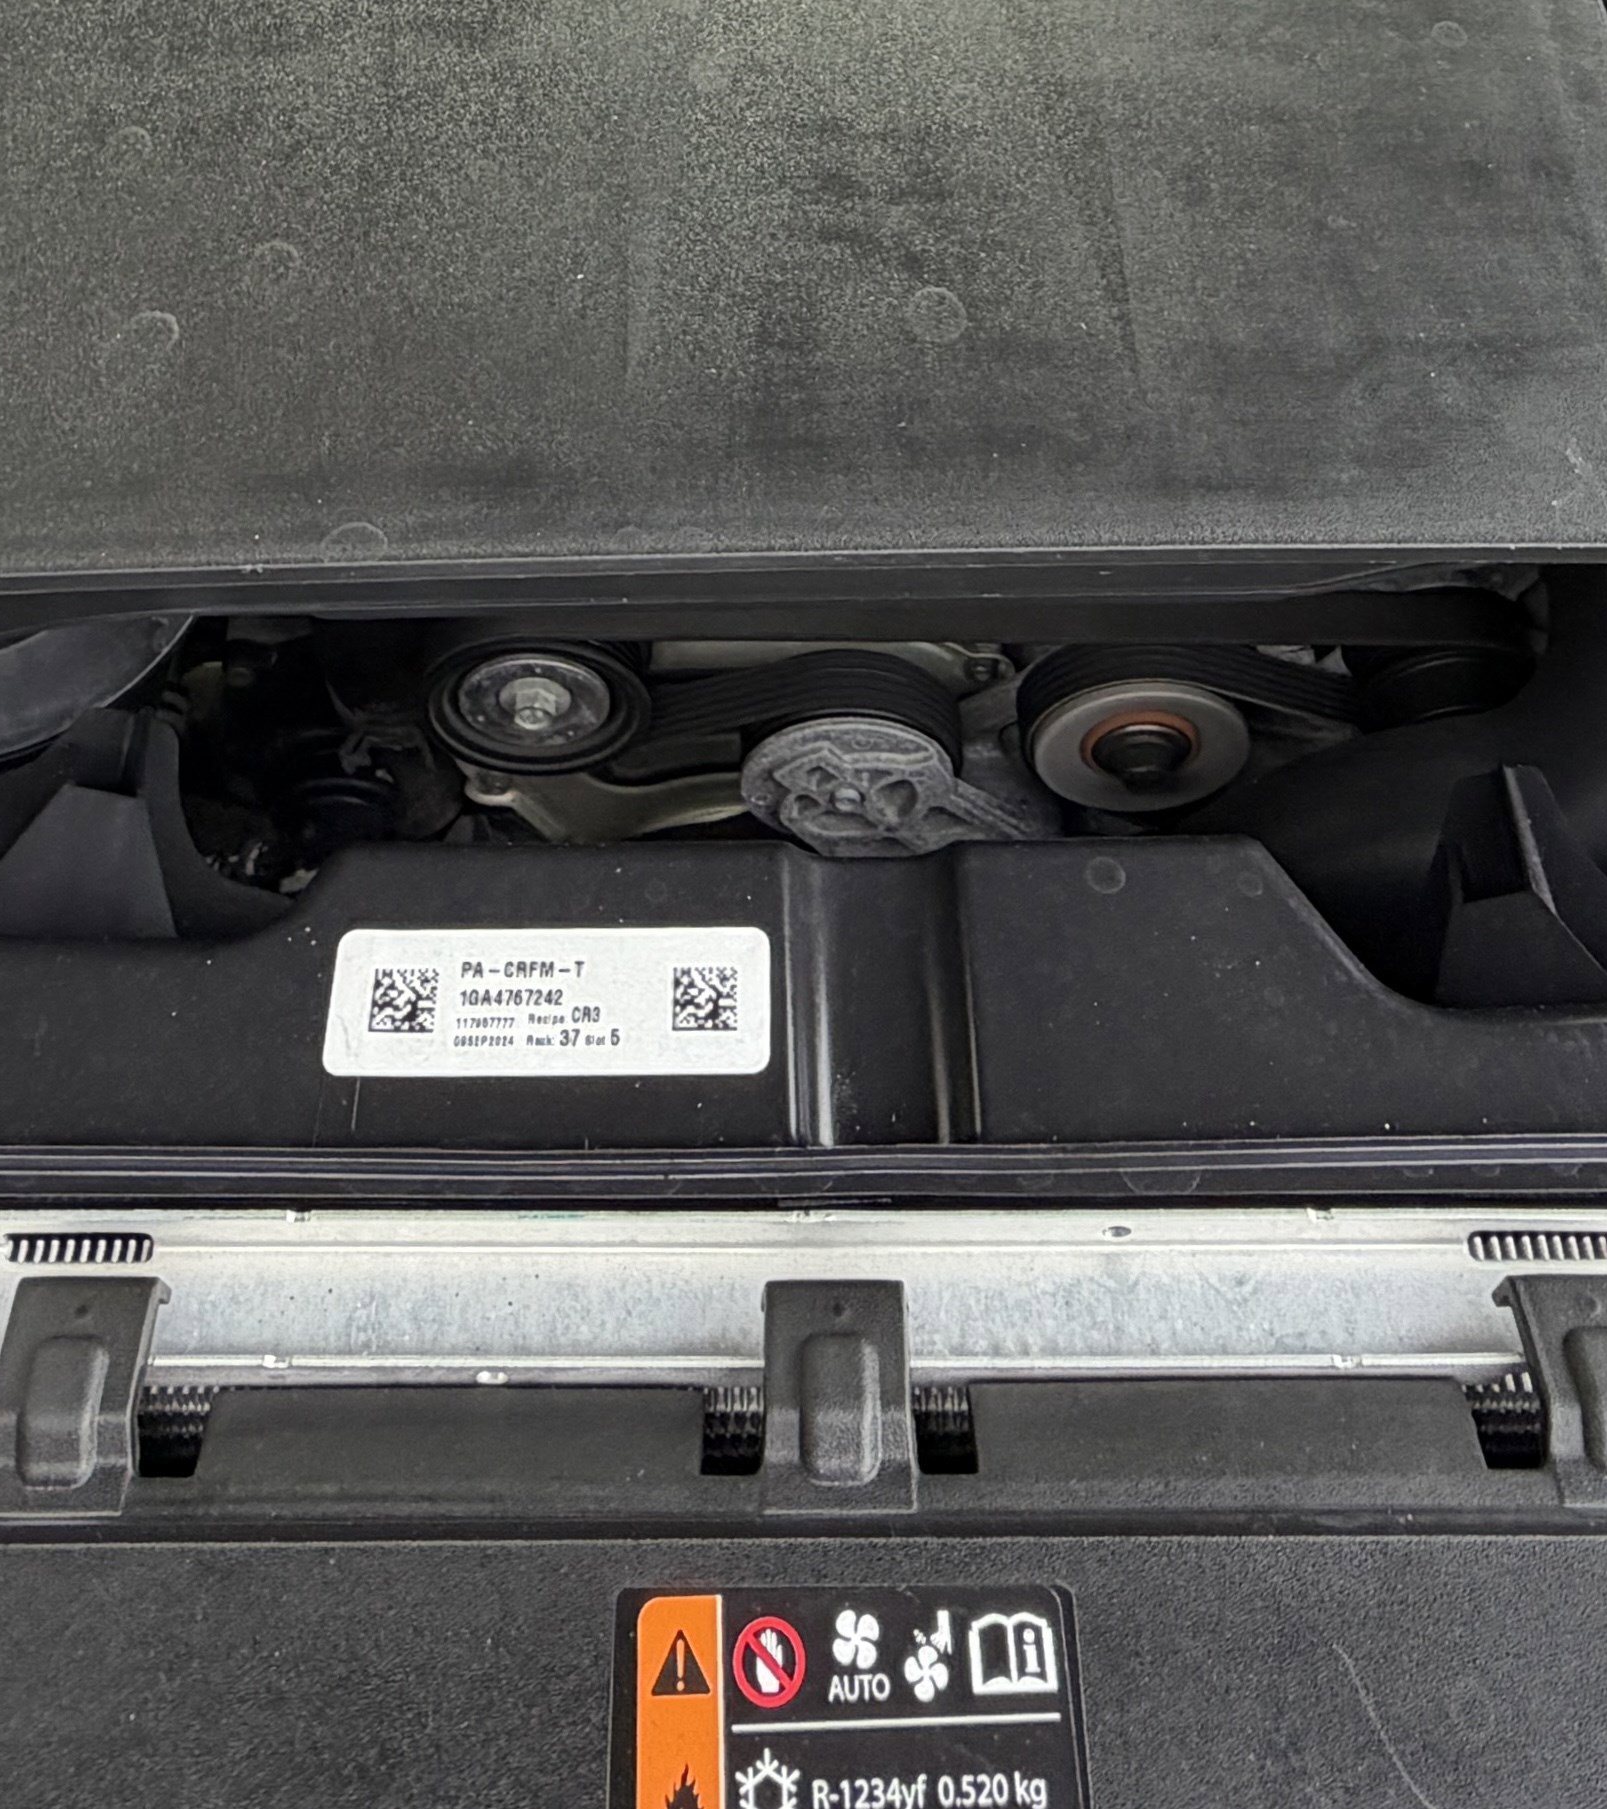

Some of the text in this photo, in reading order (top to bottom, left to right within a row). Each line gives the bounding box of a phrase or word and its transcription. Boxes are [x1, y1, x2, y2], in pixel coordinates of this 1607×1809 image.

[571, 1006, 602, 1024] CR3
[559, 1028, 581, 1048] 37
[610, 1028, 621, 1047] 5
[828, 1673, 891, 1703] AUTO
[811, 1771, 1047, 1809] R-1234yf 0.520 kg
